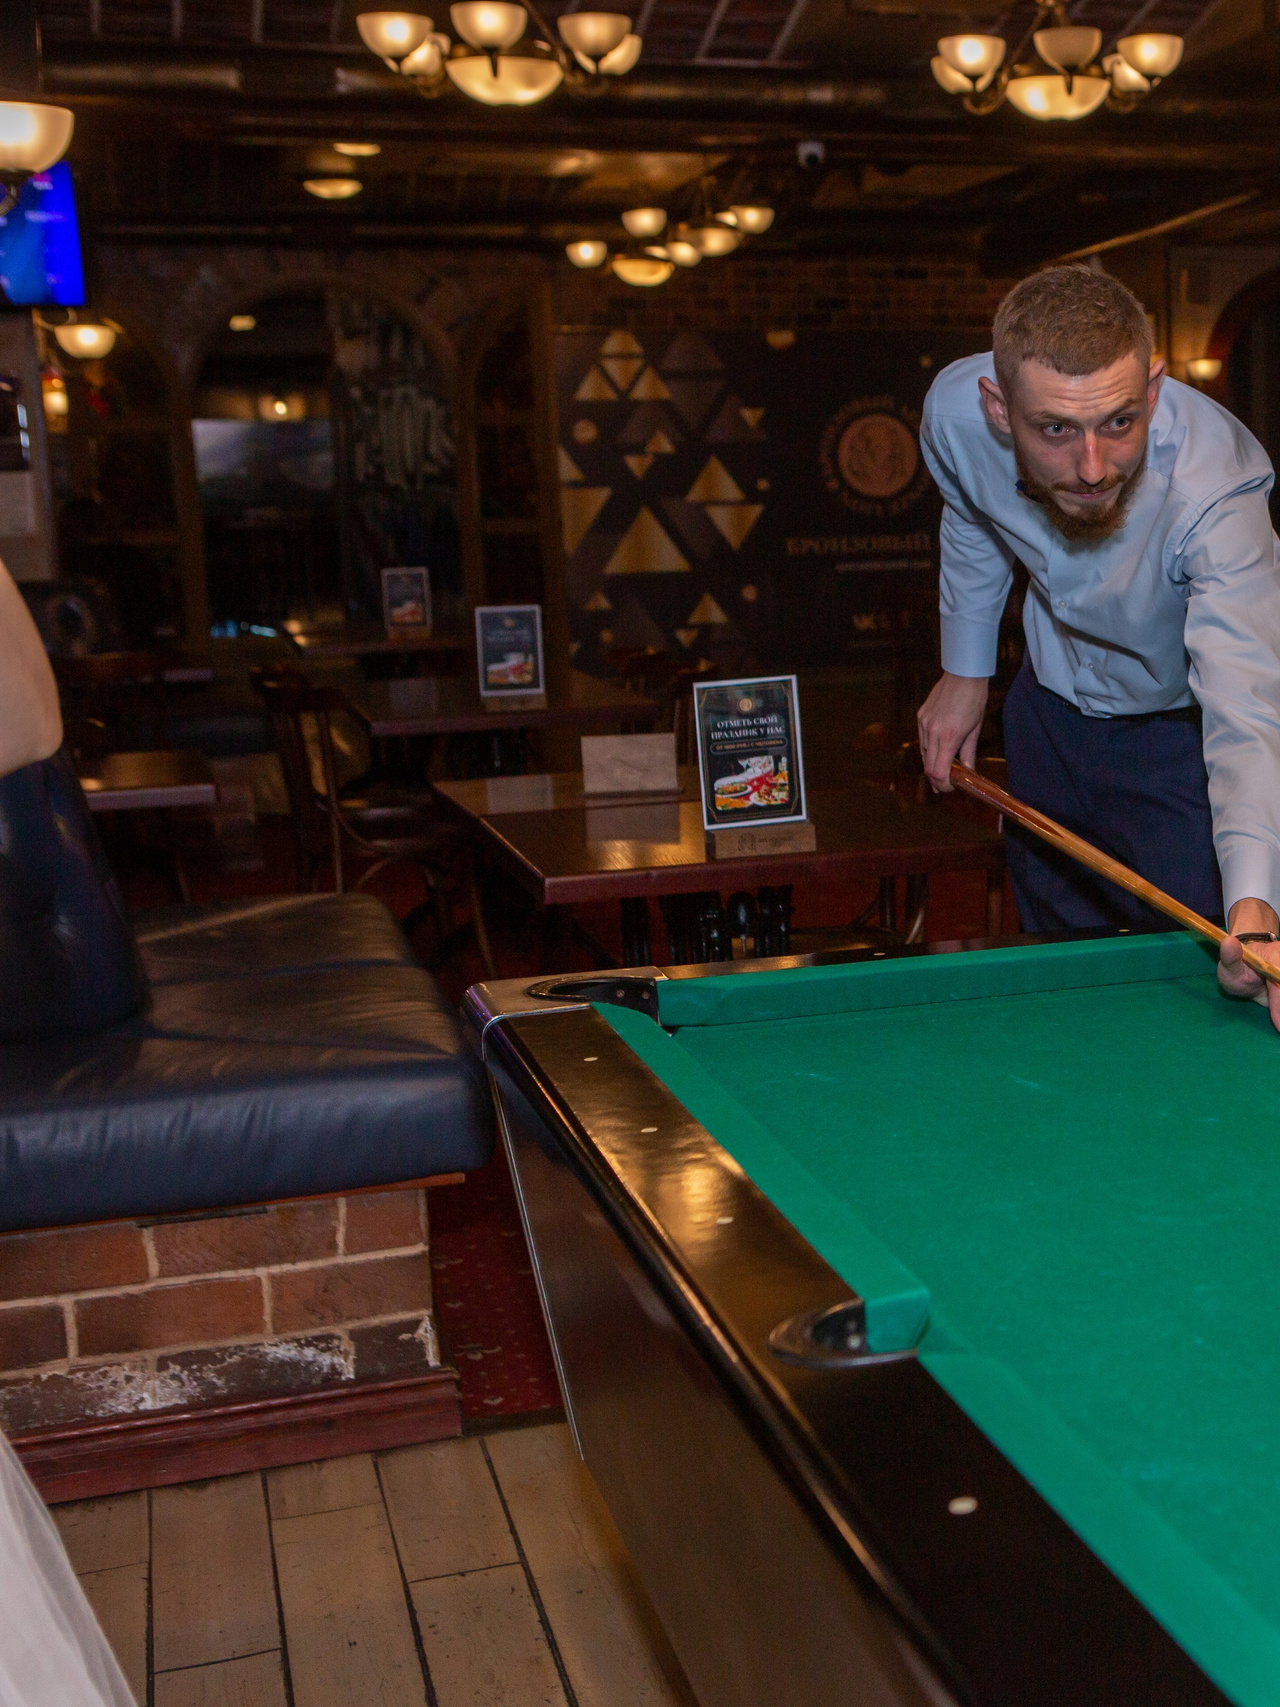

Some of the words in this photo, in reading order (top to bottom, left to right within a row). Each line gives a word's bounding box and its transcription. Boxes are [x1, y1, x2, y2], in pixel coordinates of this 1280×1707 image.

[716, 718, 752, 729] ОТМЕТЬ
[753, 714, 778, 725] СВОЙ
[711, 727, 758, 740] ПРАЗДНИК
[766, 726, 786, 735] НАС
